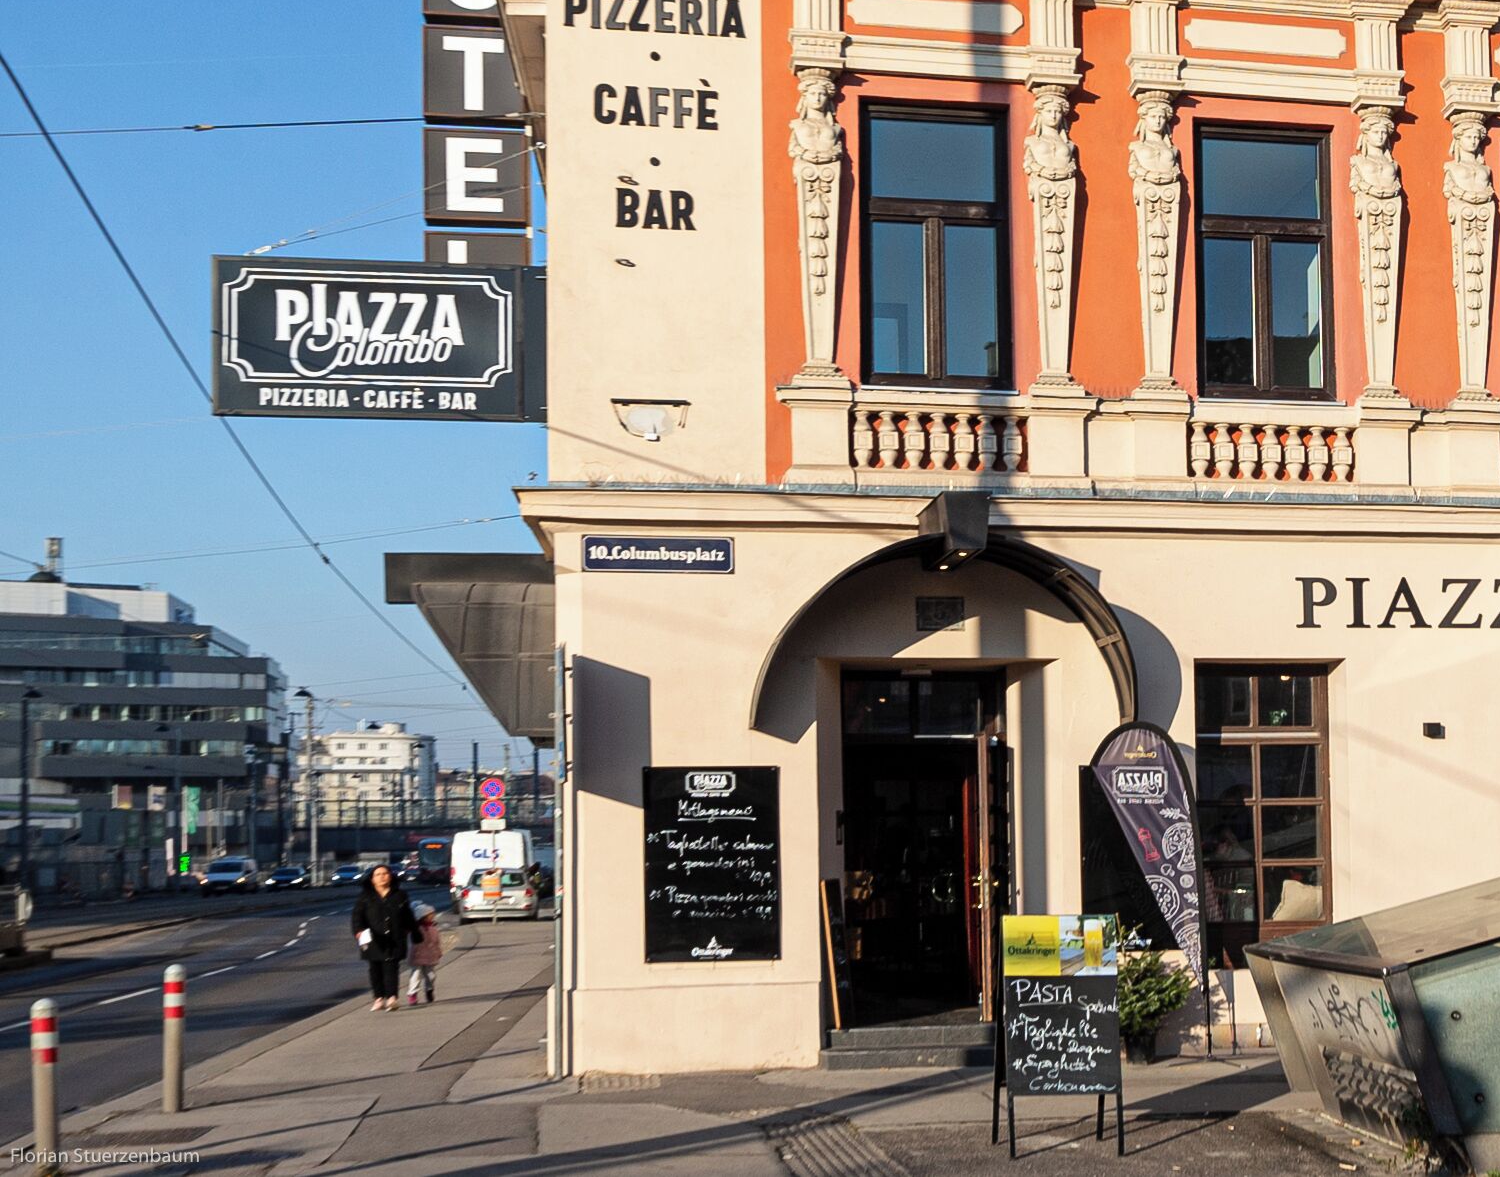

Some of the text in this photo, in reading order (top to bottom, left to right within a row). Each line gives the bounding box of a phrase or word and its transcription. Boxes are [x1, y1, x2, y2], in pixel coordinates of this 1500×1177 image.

[593, 78, 719, 131] CAFFÈ
[615, 187, 697, 231] BAR
[274, 283, 465, 347] PIAZZA
[290, 317, 453, 377] Colombo
[259, 387, 477, 410] PIZZERIA CAFFÈ BAR
[472, 848, 500, 860] GLS
[1010, 979, 1073, 1003] PASTA
